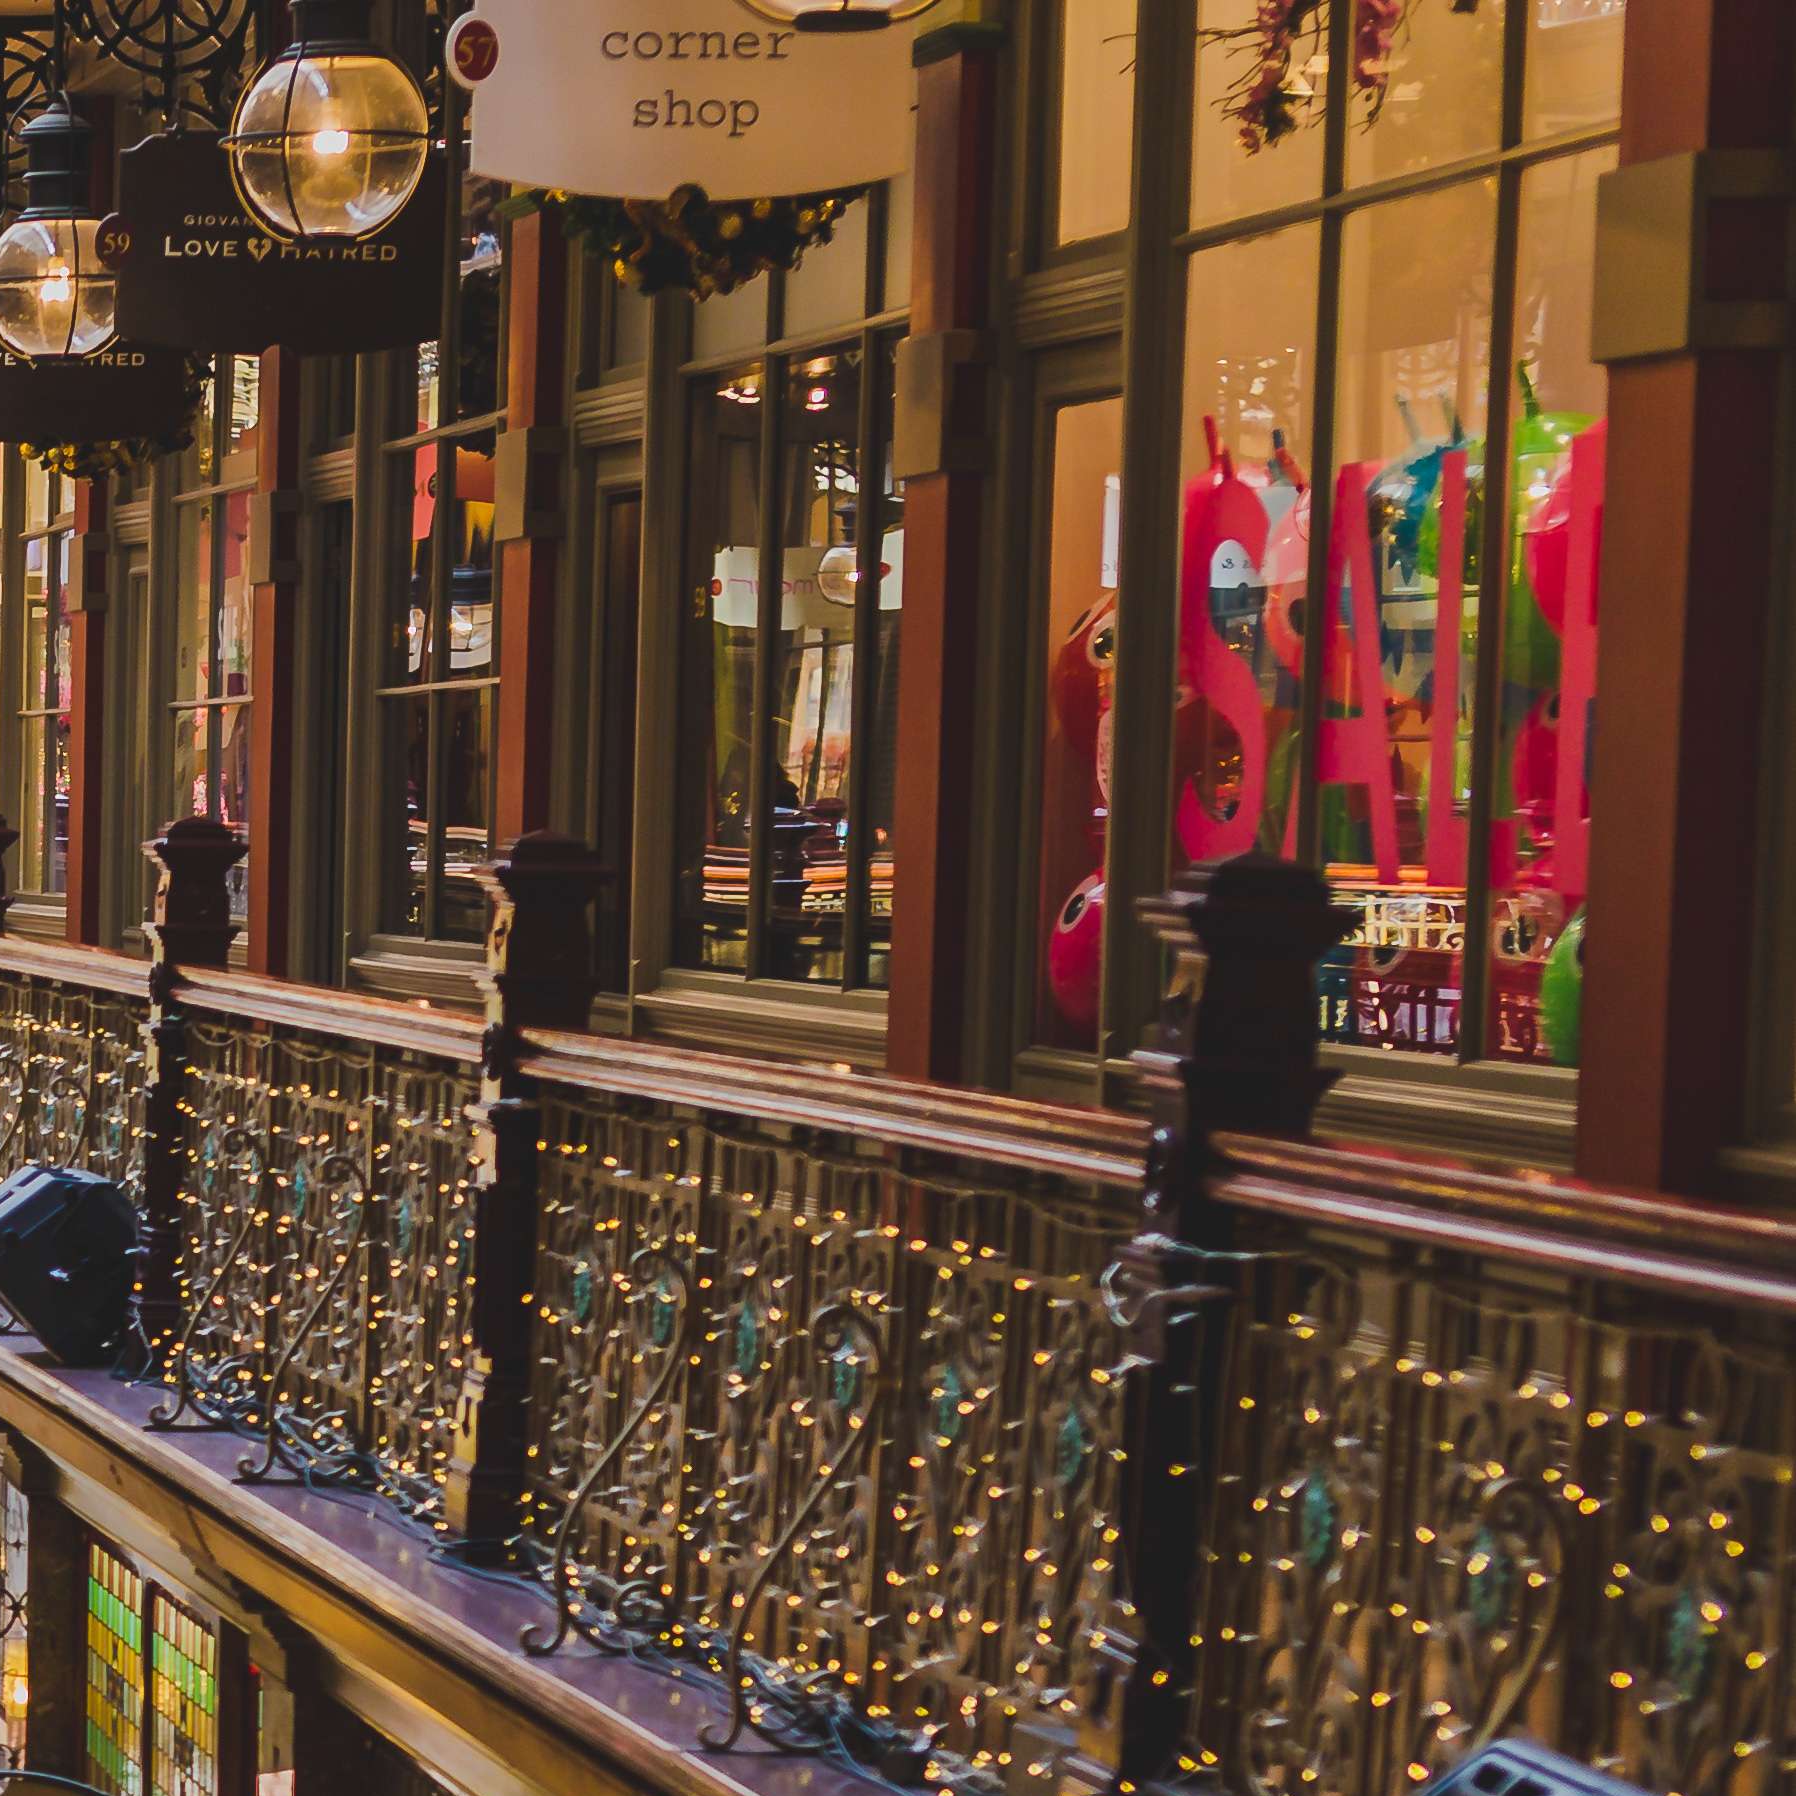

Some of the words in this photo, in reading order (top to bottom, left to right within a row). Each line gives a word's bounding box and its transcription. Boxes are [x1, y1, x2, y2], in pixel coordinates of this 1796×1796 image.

[457, 35, 497, 69] 57
[601, 29, 796, 61] corner
[632, 89, 760, 139] shop
[103, 232, 131, 254] 59
[164, 235, 238, 257] LOVE
